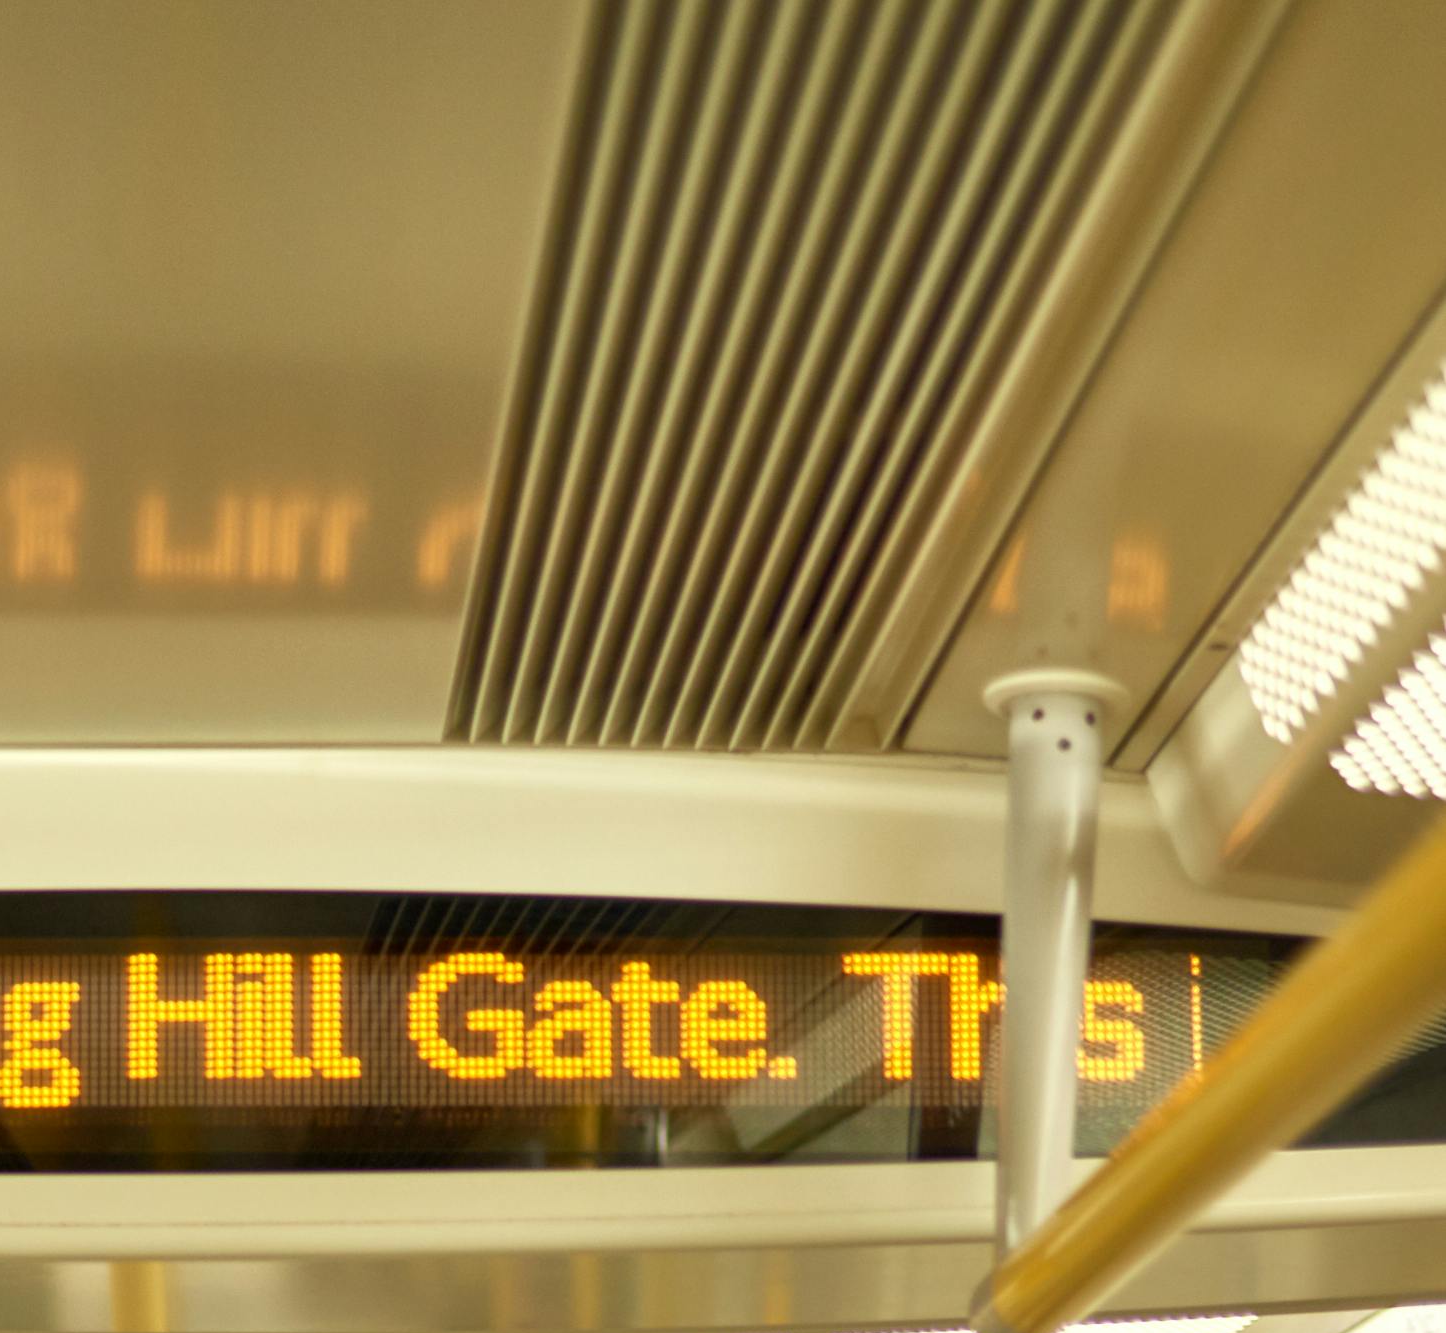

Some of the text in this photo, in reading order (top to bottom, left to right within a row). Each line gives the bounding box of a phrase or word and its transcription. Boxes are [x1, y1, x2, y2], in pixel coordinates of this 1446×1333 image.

[127, 952, 361, 1079] Hill
[407, 952, 797, 1080] Gate.
[842, 952, 1145, 1081] Ths
